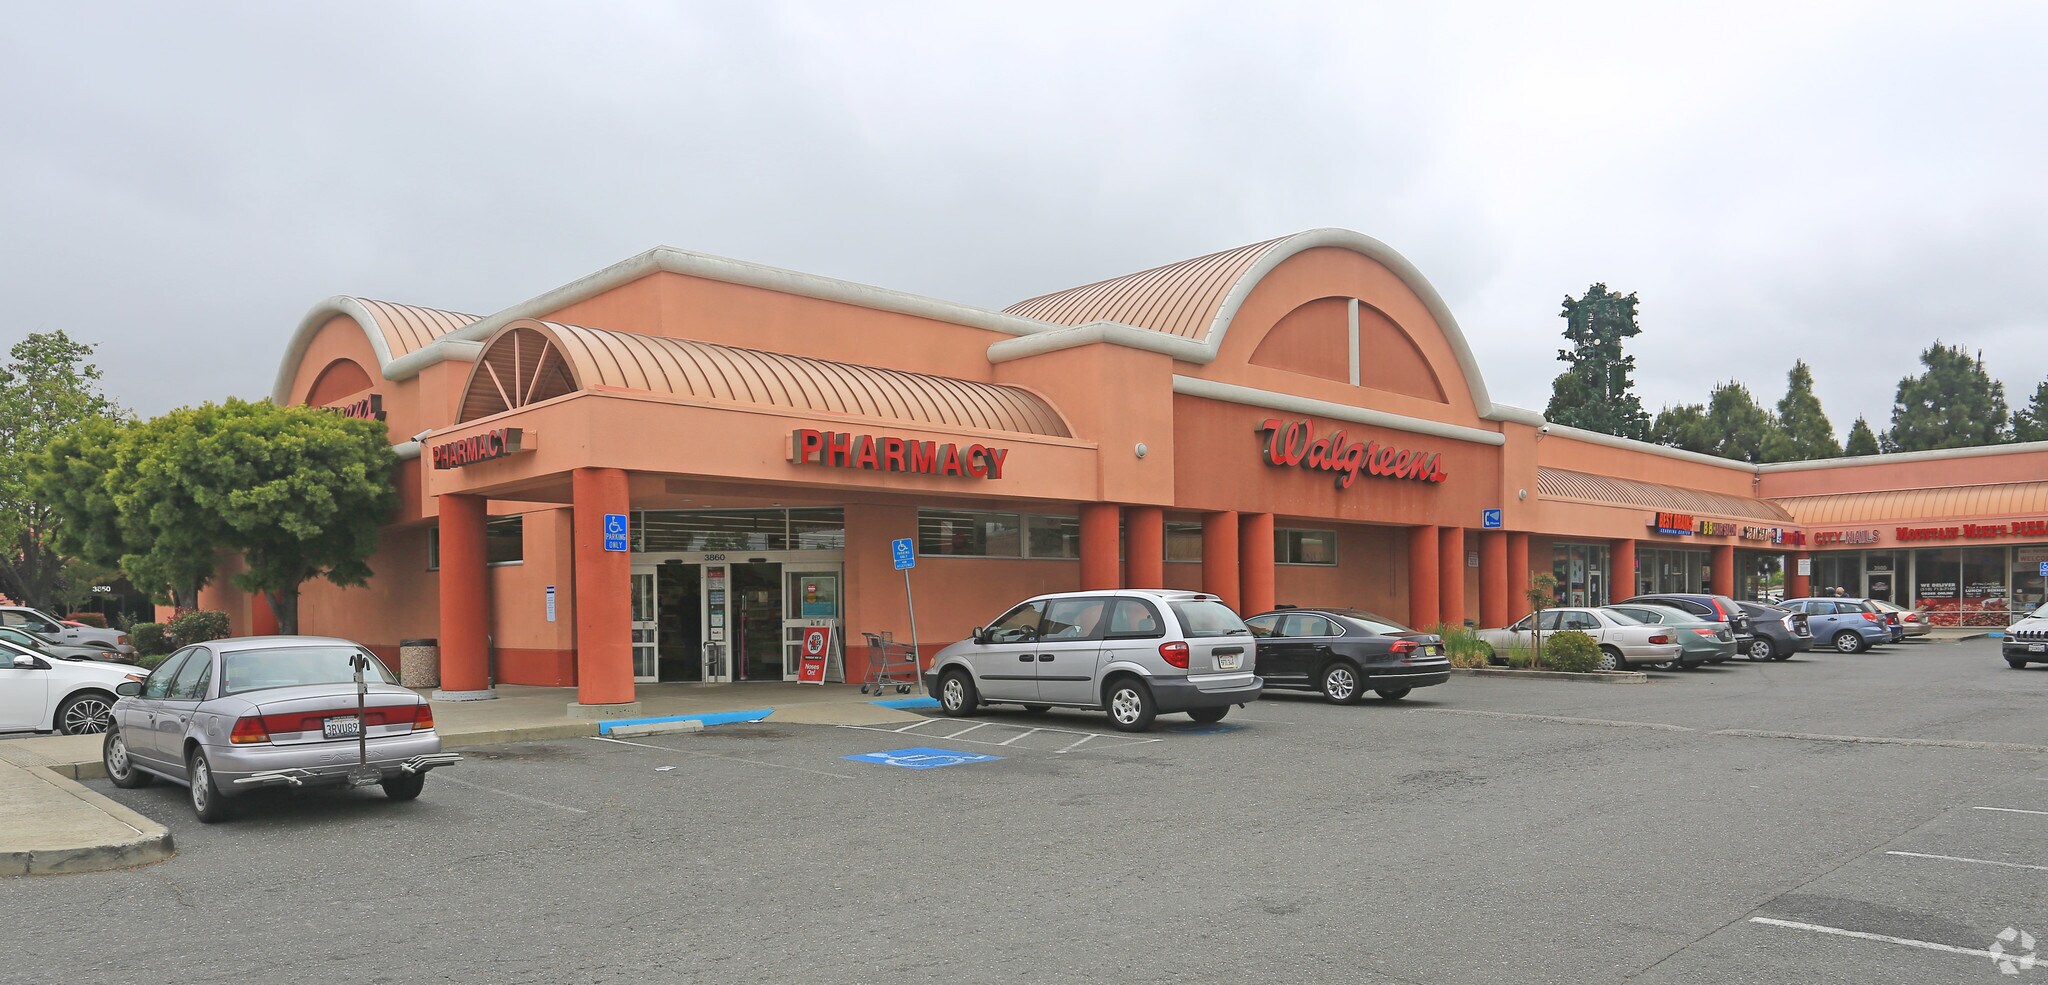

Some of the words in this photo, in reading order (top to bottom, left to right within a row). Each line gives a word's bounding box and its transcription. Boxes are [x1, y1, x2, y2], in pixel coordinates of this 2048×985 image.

[432, 427, 510, 470] PHARMACY
[793, 428, 1009, 480] PHARMACY
[1255, 418, 1448, 489] Walgreens
[1658, 512, 1673, 528] BEST
[606, 533, 626, 541] PARKING
[1814, 532, 1842, 545] CITY
[1845, 529, 1880, 544] NAILS
[1896, 526, 1959, 541] MOUNTAIN
[1963, 523, 2007, 539] MIKE'S
[609, 541, 623, 549] ONLY
[704, 553, 726, 561] 3860
[326, 722, 360, 735] 3RVU89
